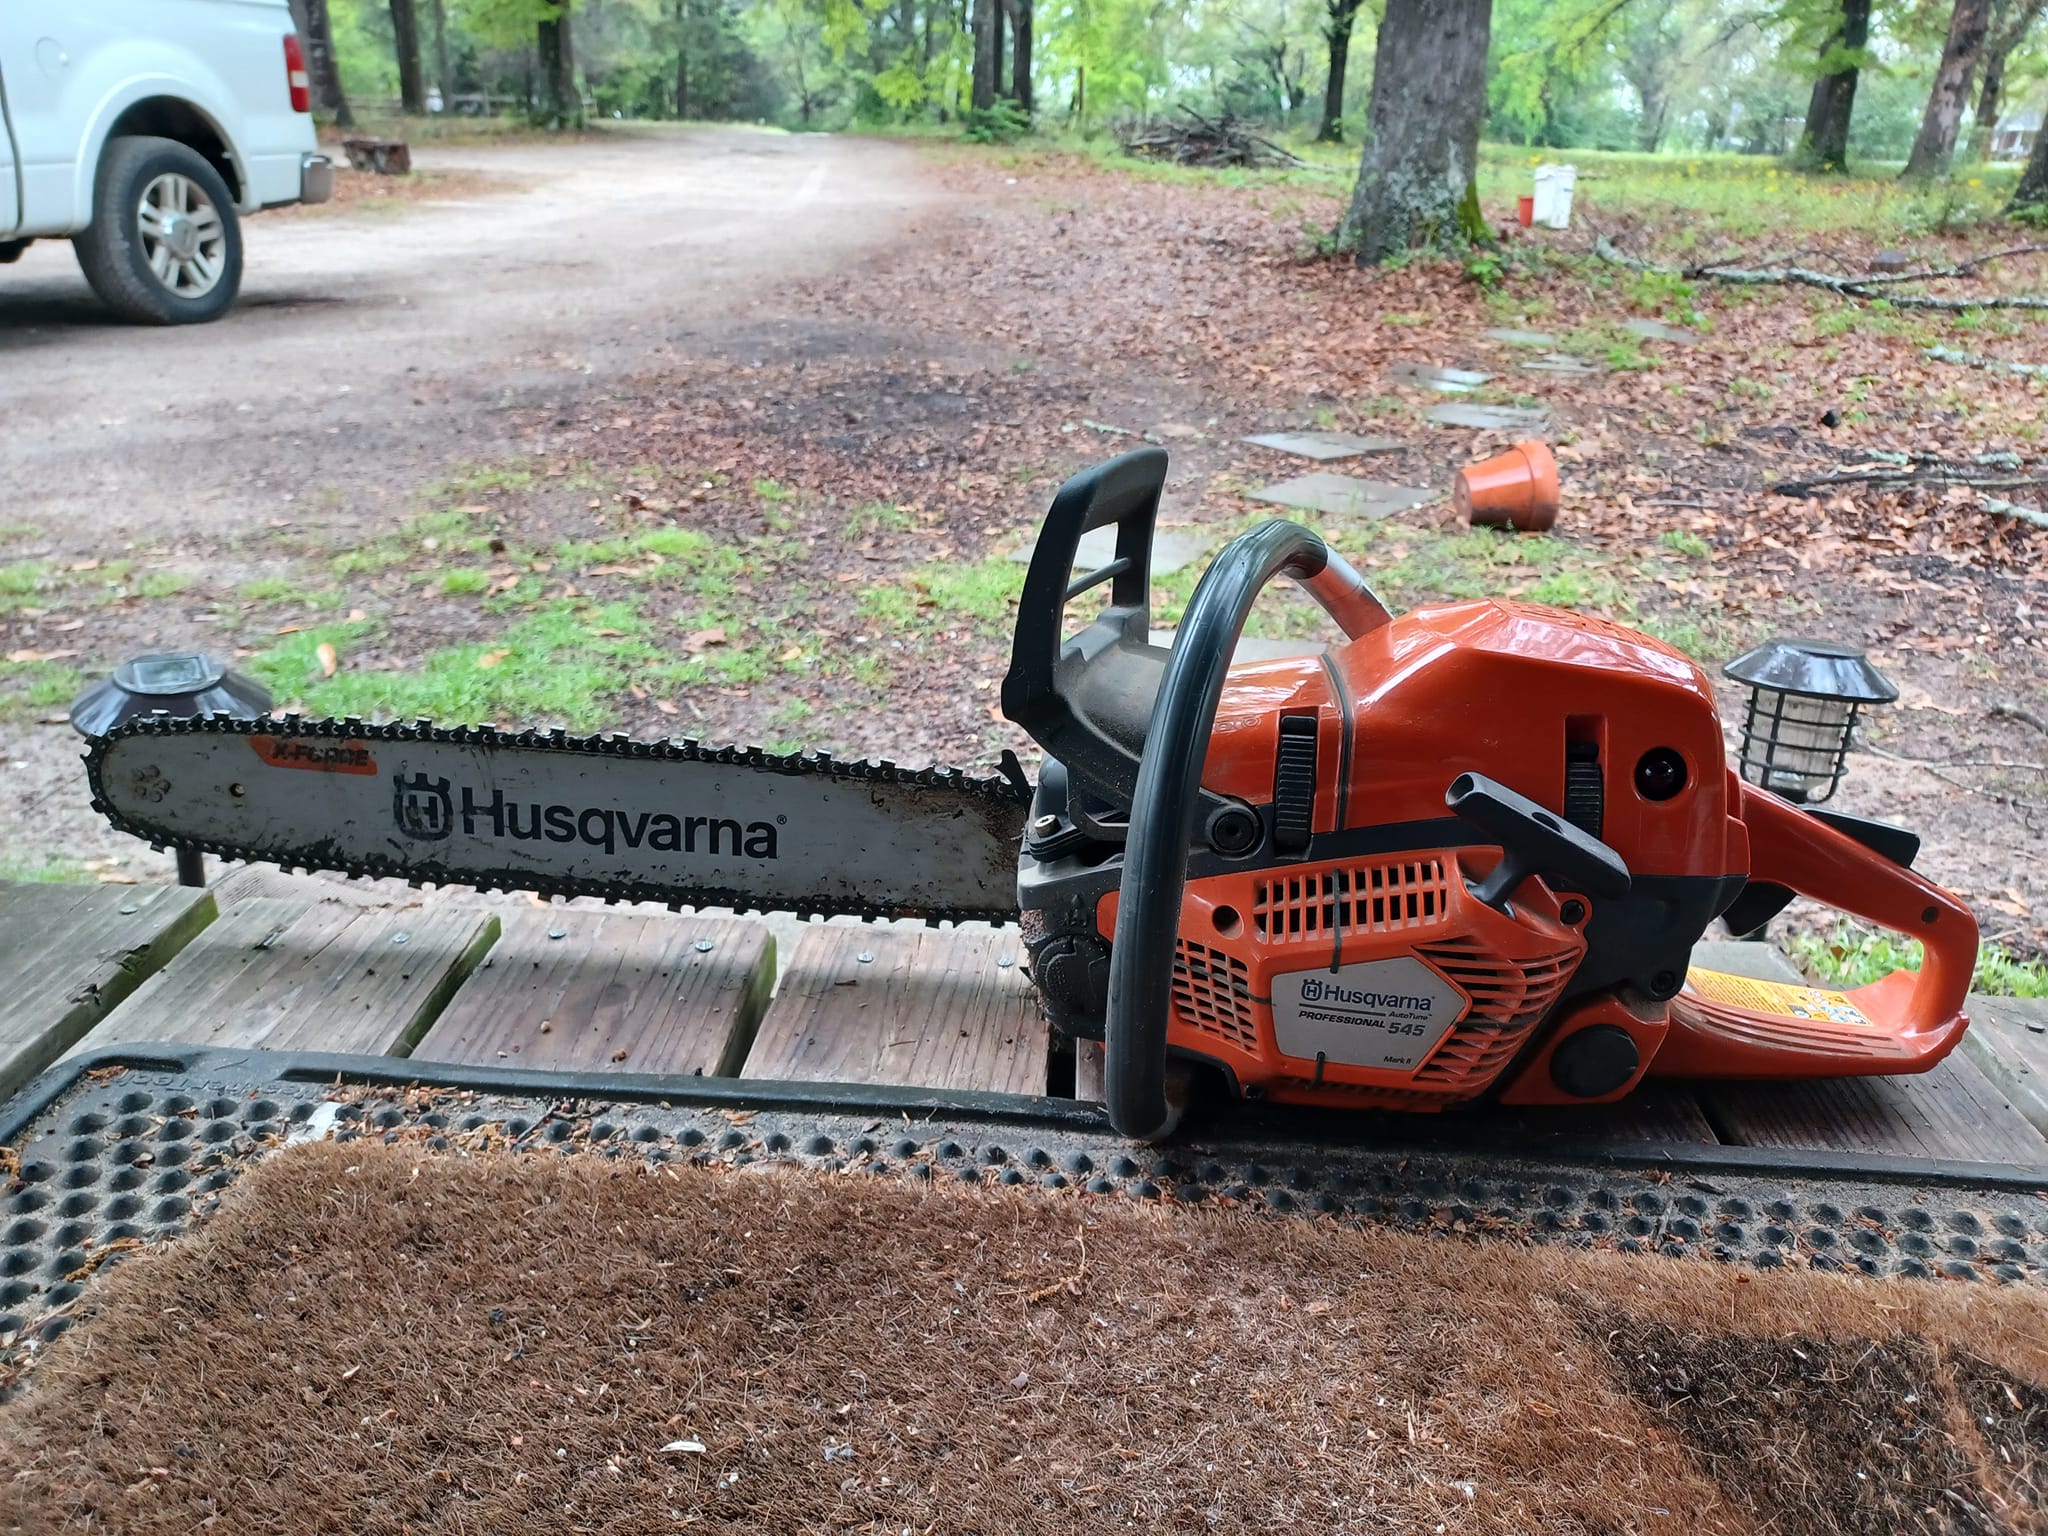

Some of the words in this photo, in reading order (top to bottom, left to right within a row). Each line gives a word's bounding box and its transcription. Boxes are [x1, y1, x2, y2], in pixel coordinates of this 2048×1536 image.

[461, 787, 778, 859] Husqvarna
[1324, 984, 1432, 1011] Husqvarna
[1298, 1010, 1386, 1029] PROFESSIONAL
[1387, 1022, 1426, 1037] 545
[1383, 1055, 1404, 1065] Mark
